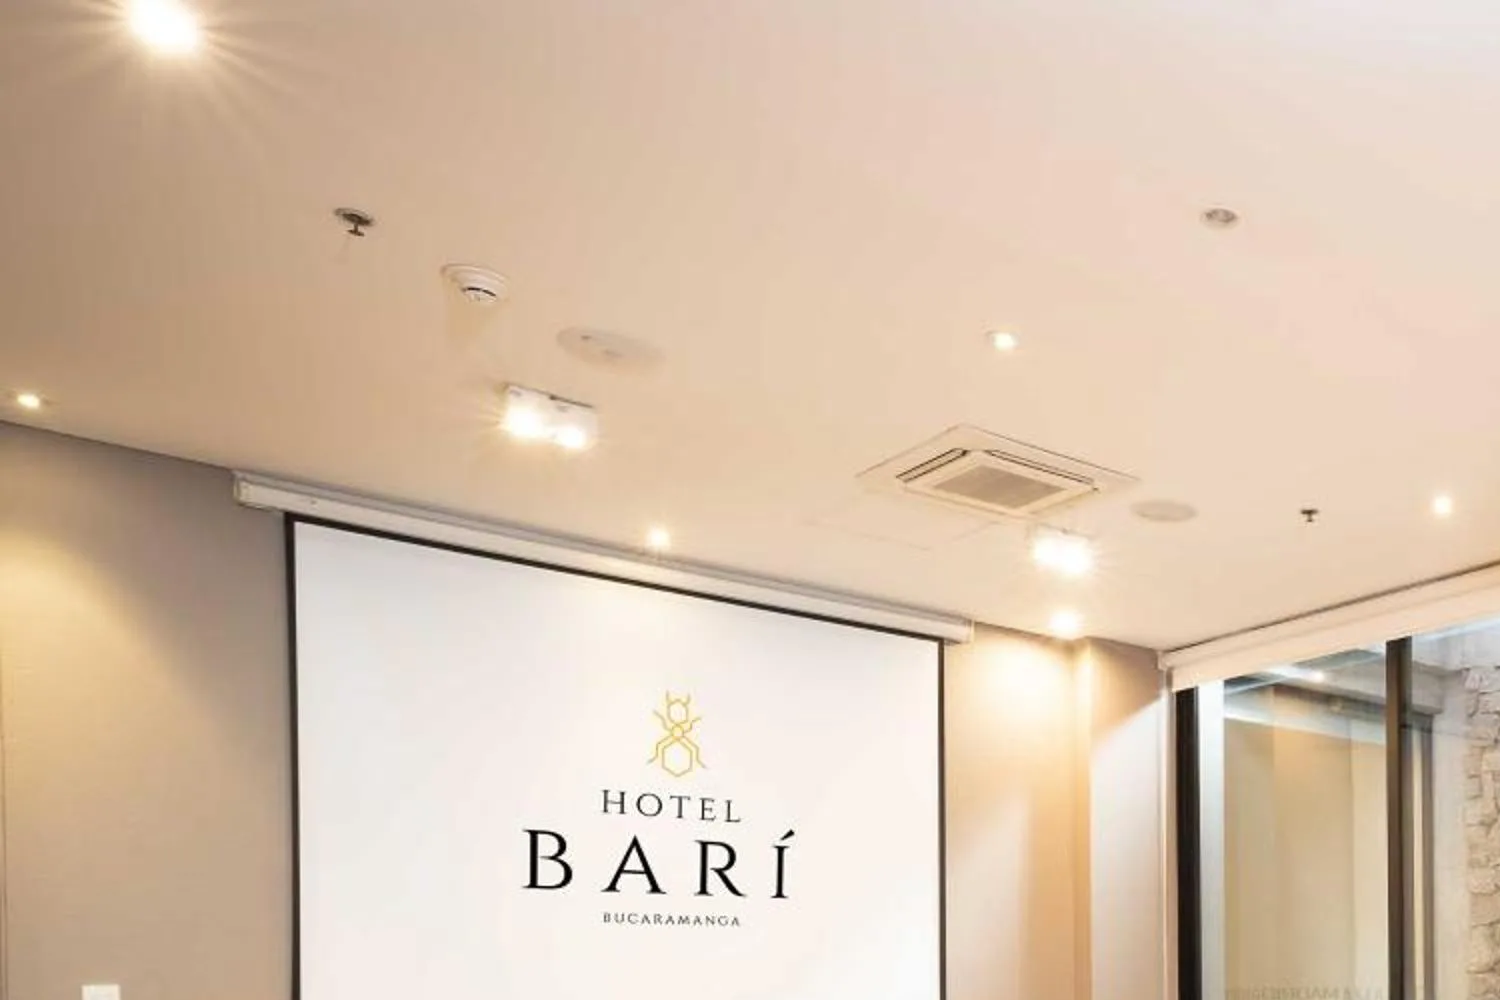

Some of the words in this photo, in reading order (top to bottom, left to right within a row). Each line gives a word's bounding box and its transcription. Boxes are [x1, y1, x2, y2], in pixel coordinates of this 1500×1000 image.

[602, 789, 741, 823] HOTEL
[522, 828, 795, 899] BARÍ
[603, 911, 740, 927] BUCARAMANGA
